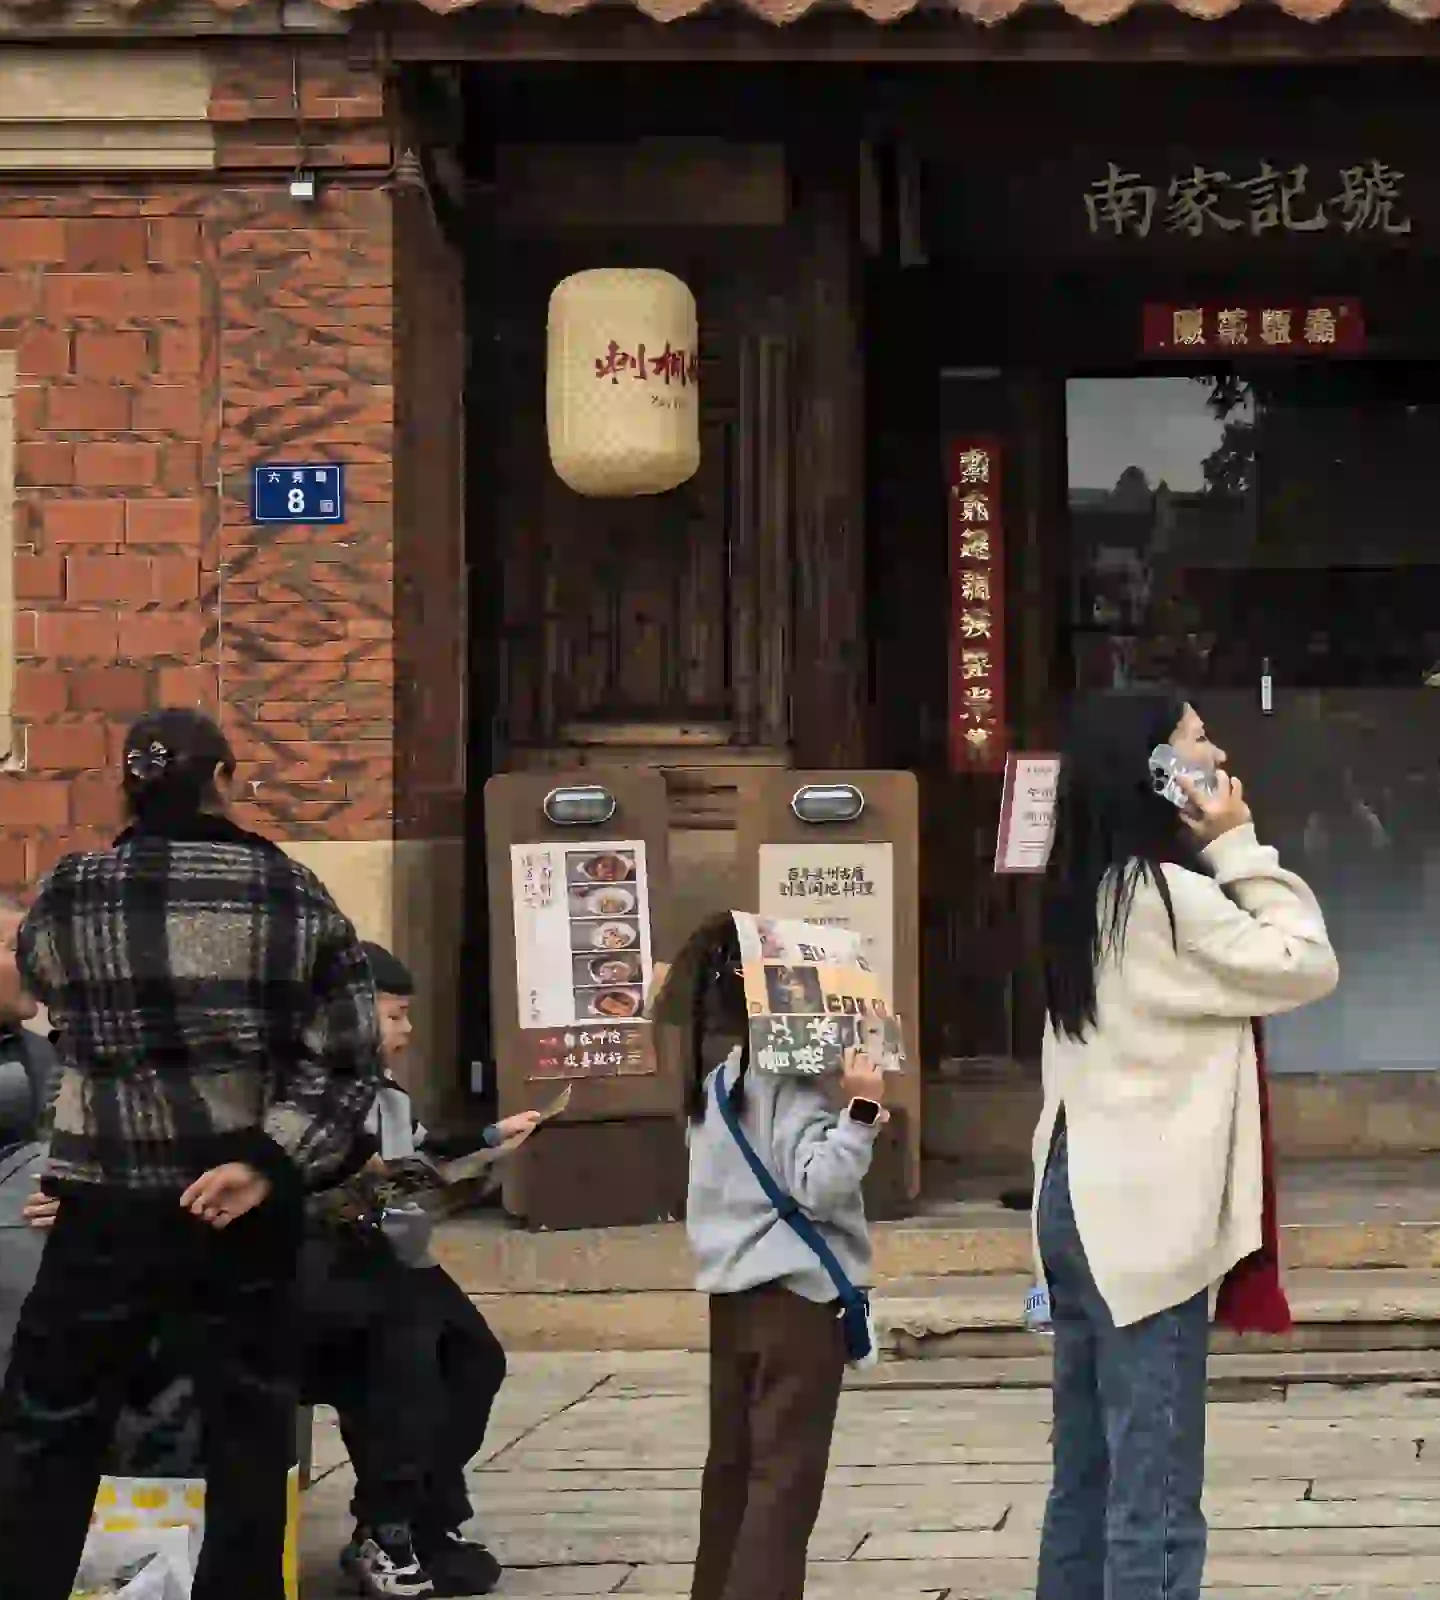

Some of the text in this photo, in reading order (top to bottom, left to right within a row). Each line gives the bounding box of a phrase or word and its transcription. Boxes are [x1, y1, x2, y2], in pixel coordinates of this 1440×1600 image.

[1083, 158, 1413, 238] 南家記號
[288, 488, 305, 513] 8
